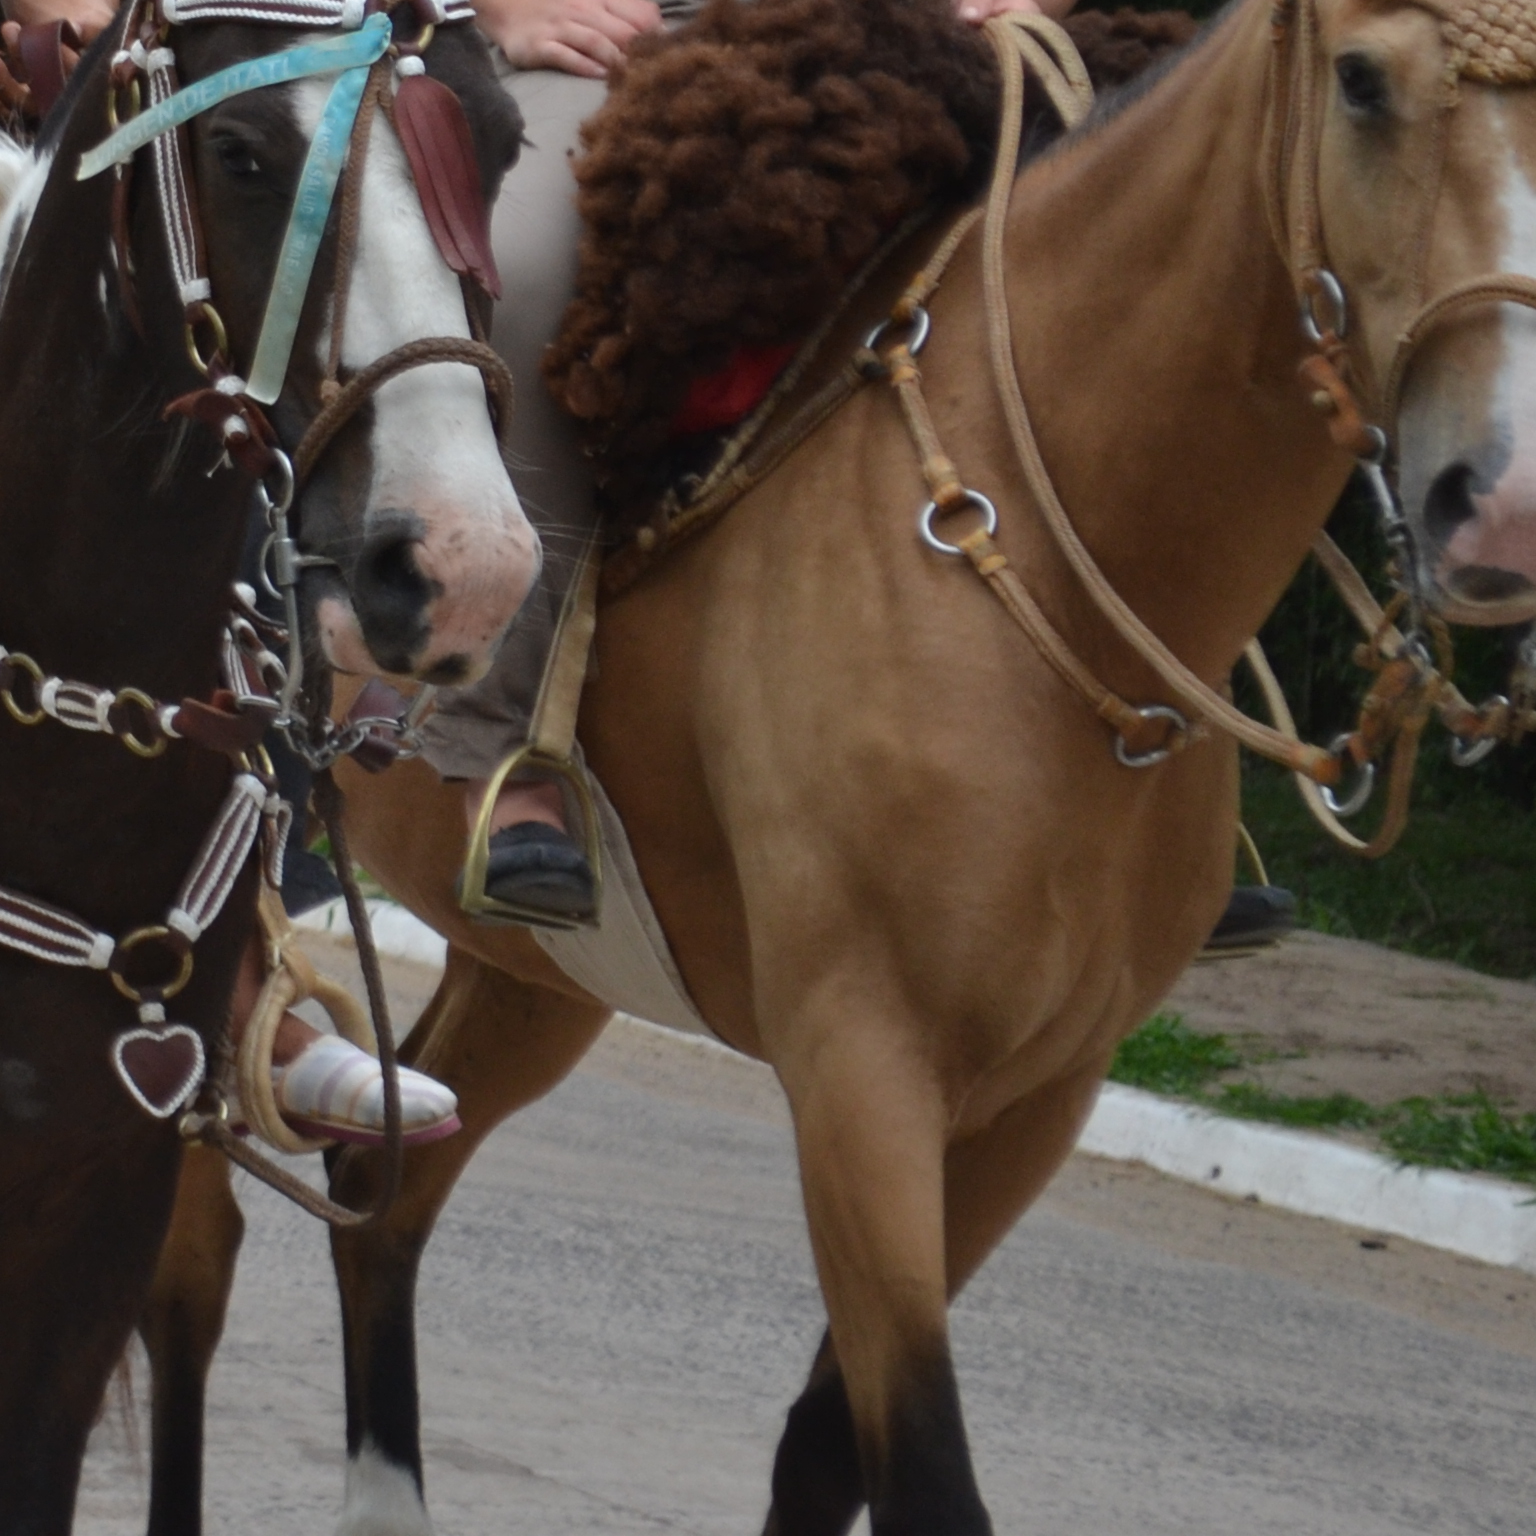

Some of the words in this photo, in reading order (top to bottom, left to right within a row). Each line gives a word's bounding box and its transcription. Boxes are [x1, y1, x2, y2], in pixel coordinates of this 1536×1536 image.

[89, 105, 173, 164] VIRGEN
[182, 80, 217, 112] DE
[221, 57, 290, 95] ITATI
[300, 167, 323, 214] SALUD
